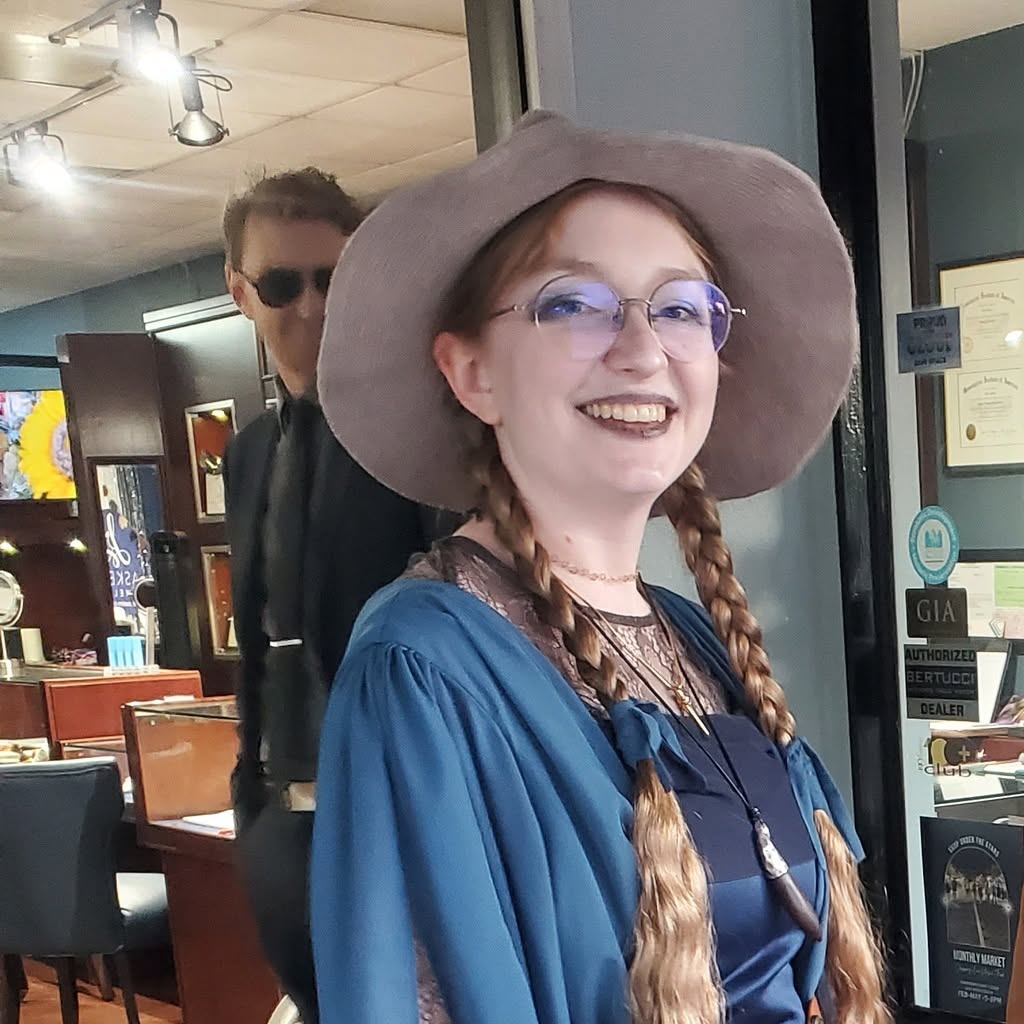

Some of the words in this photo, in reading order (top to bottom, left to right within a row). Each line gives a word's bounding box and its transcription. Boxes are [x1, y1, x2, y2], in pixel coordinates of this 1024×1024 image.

[916, 599, 956, 622] GIA
[905, 648, 976, 662] AUTHORIZED
[907, 671, 975, 685] BERTUCCI
[920, 703, 964, 717] DEALER
[924, 763, 971, 777] club
[953, 949, 980, 963] MONTHLY
[981, 953, 1006, 968] MARKET
